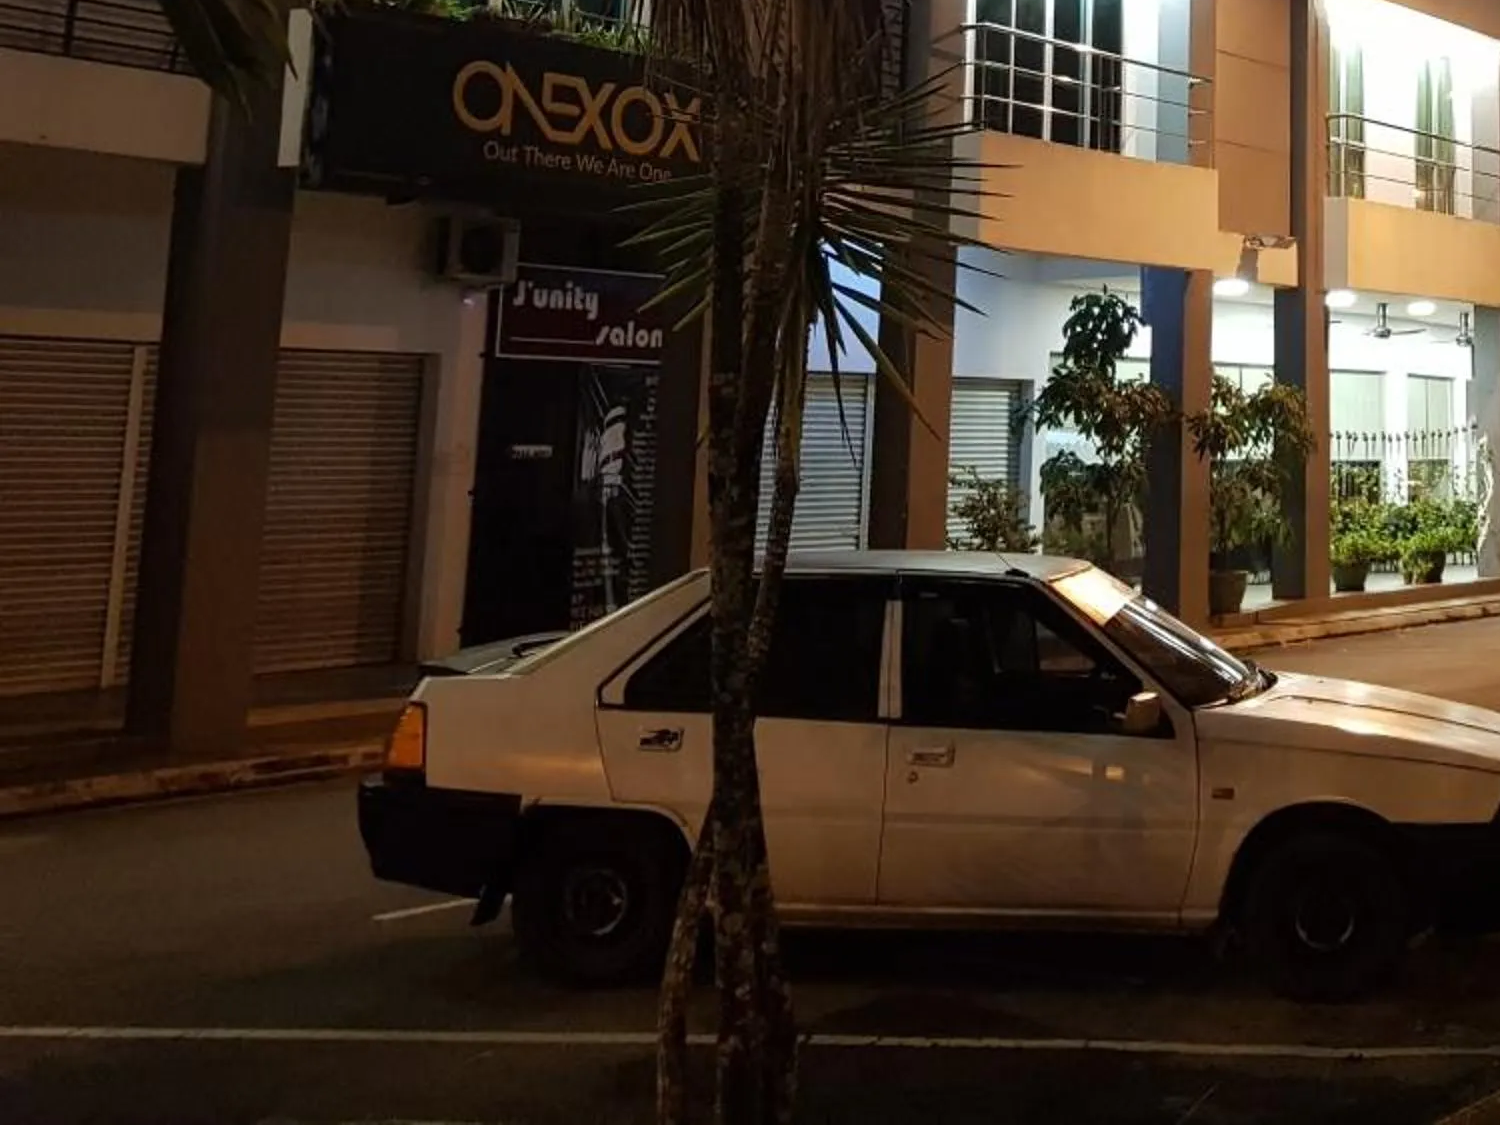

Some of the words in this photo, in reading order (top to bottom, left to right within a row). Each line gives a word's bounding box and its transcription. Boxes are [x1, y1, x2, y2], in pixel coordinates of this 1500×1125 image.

[482, 139, 519, 163] Out
[521, 144, 573, 172] There
[575, 153, 605, 174] We
[607, 156, 637, 180] Are
[638, 161, 673, 183] One
[512, 278, 600, 322] J'unity
[594, 319, 664, 349] salon
